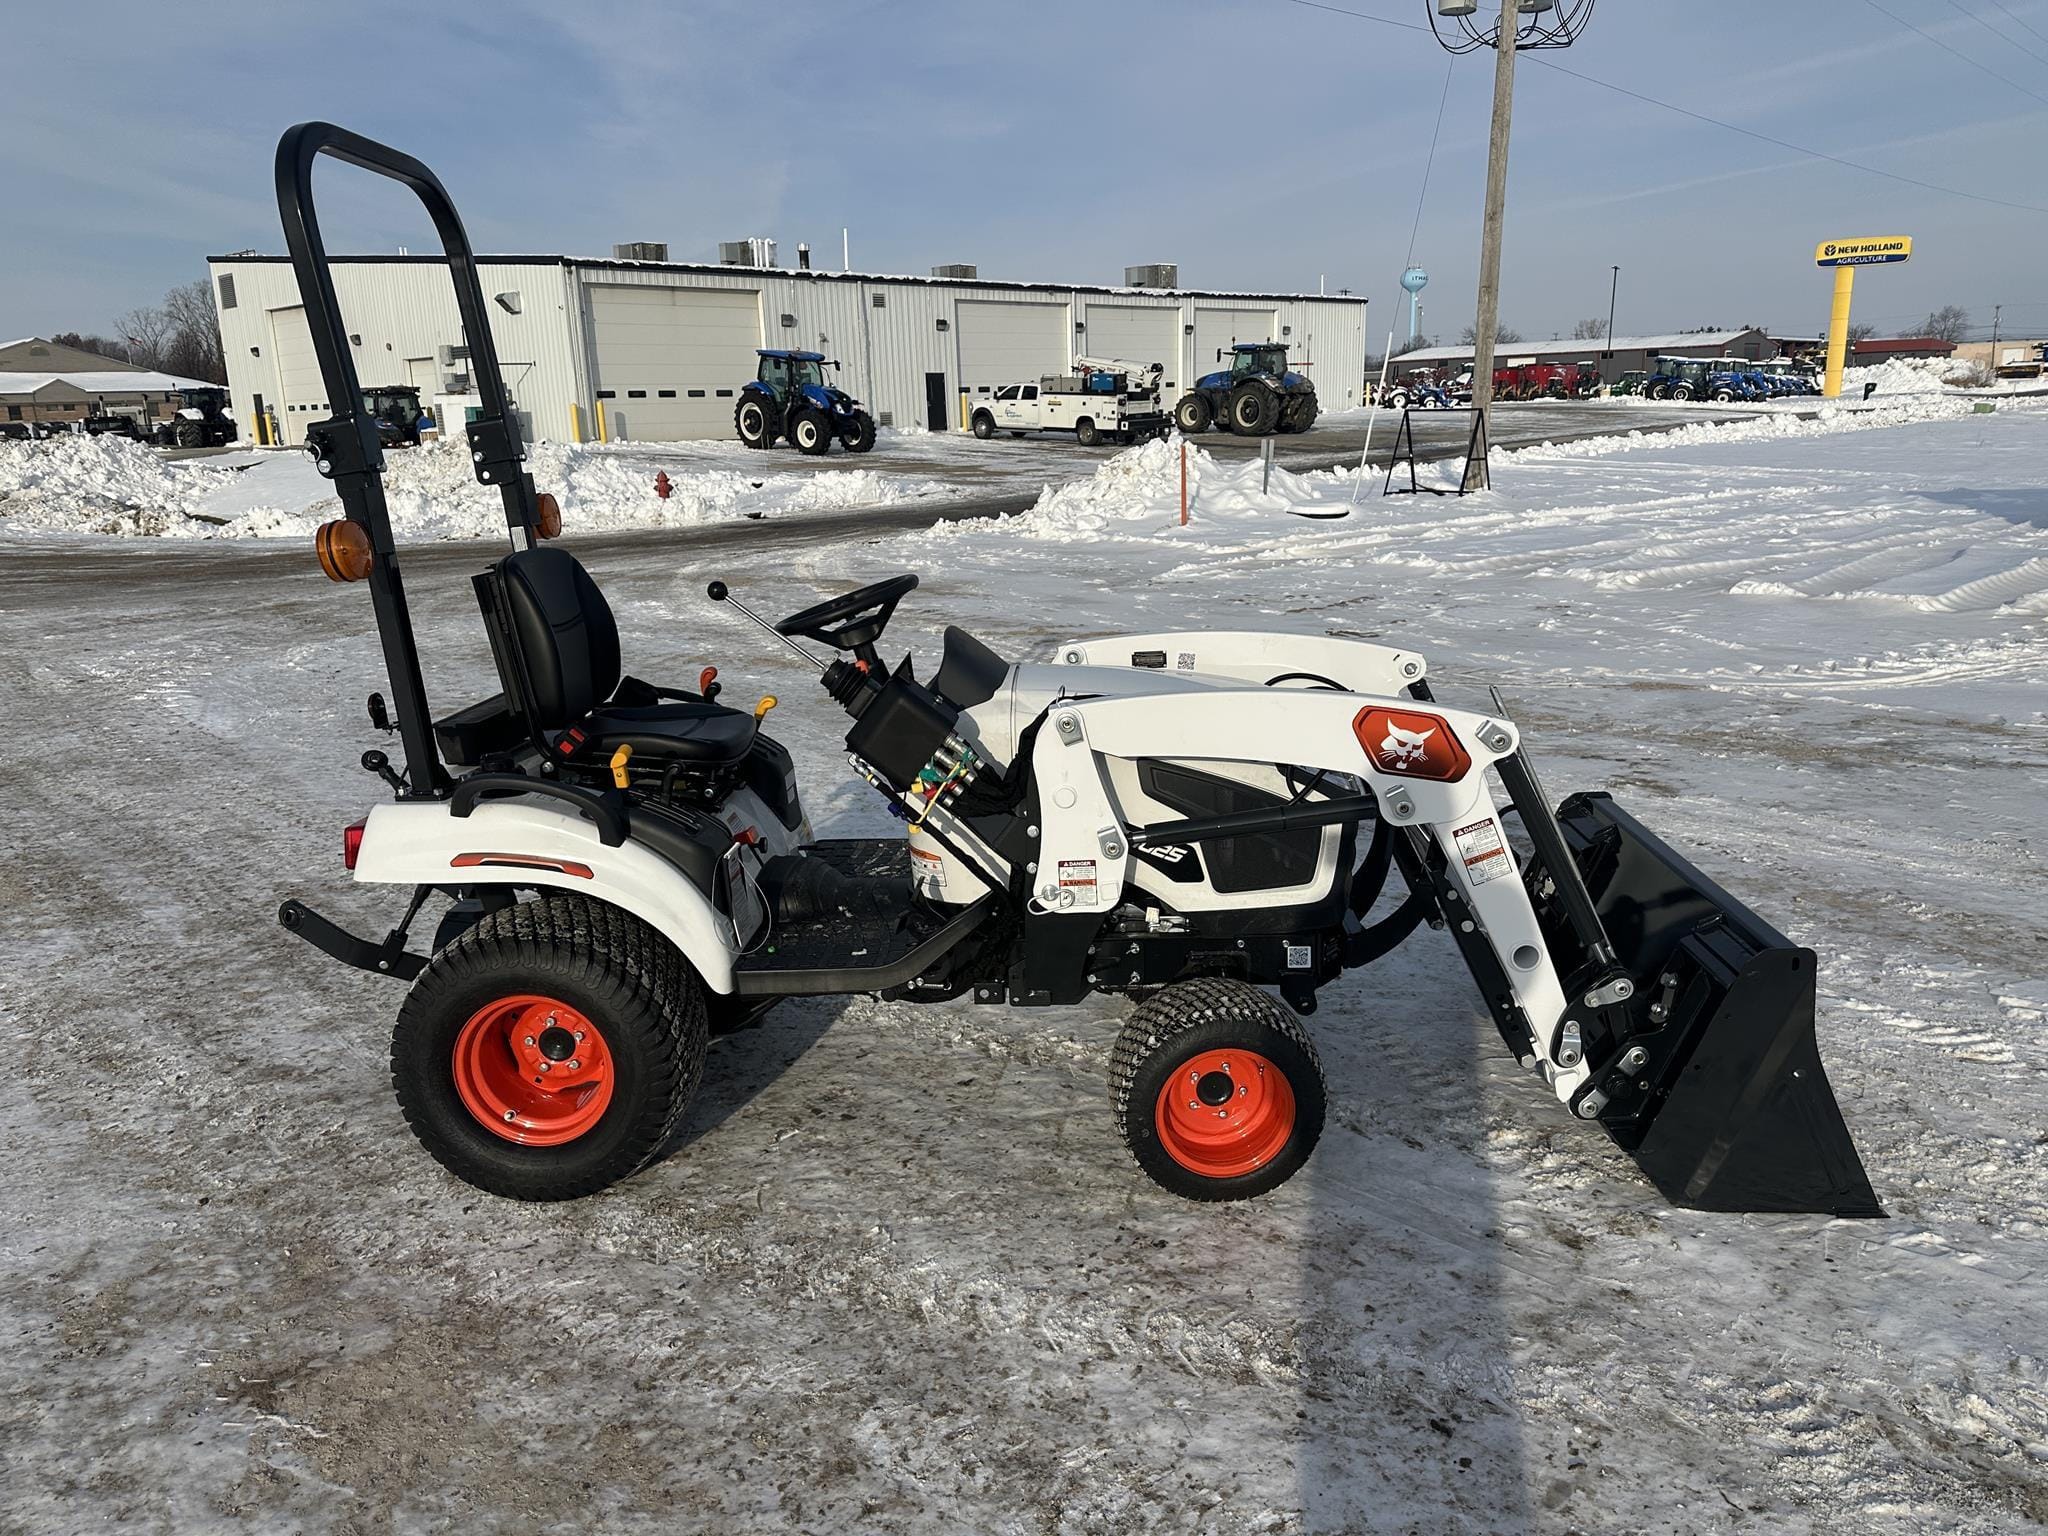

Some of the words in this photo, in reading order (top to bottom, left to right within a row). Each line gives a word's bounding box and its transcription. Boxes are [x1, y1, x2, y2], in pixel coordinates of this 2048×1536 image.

[1838, 245, 1859, 254] NEW
[1860, 242, 1903, 253] HOLLAND
[1836, 254, 1888, 264] AGRICULTURE
[1463, 820, 1490, 834] DANGER
